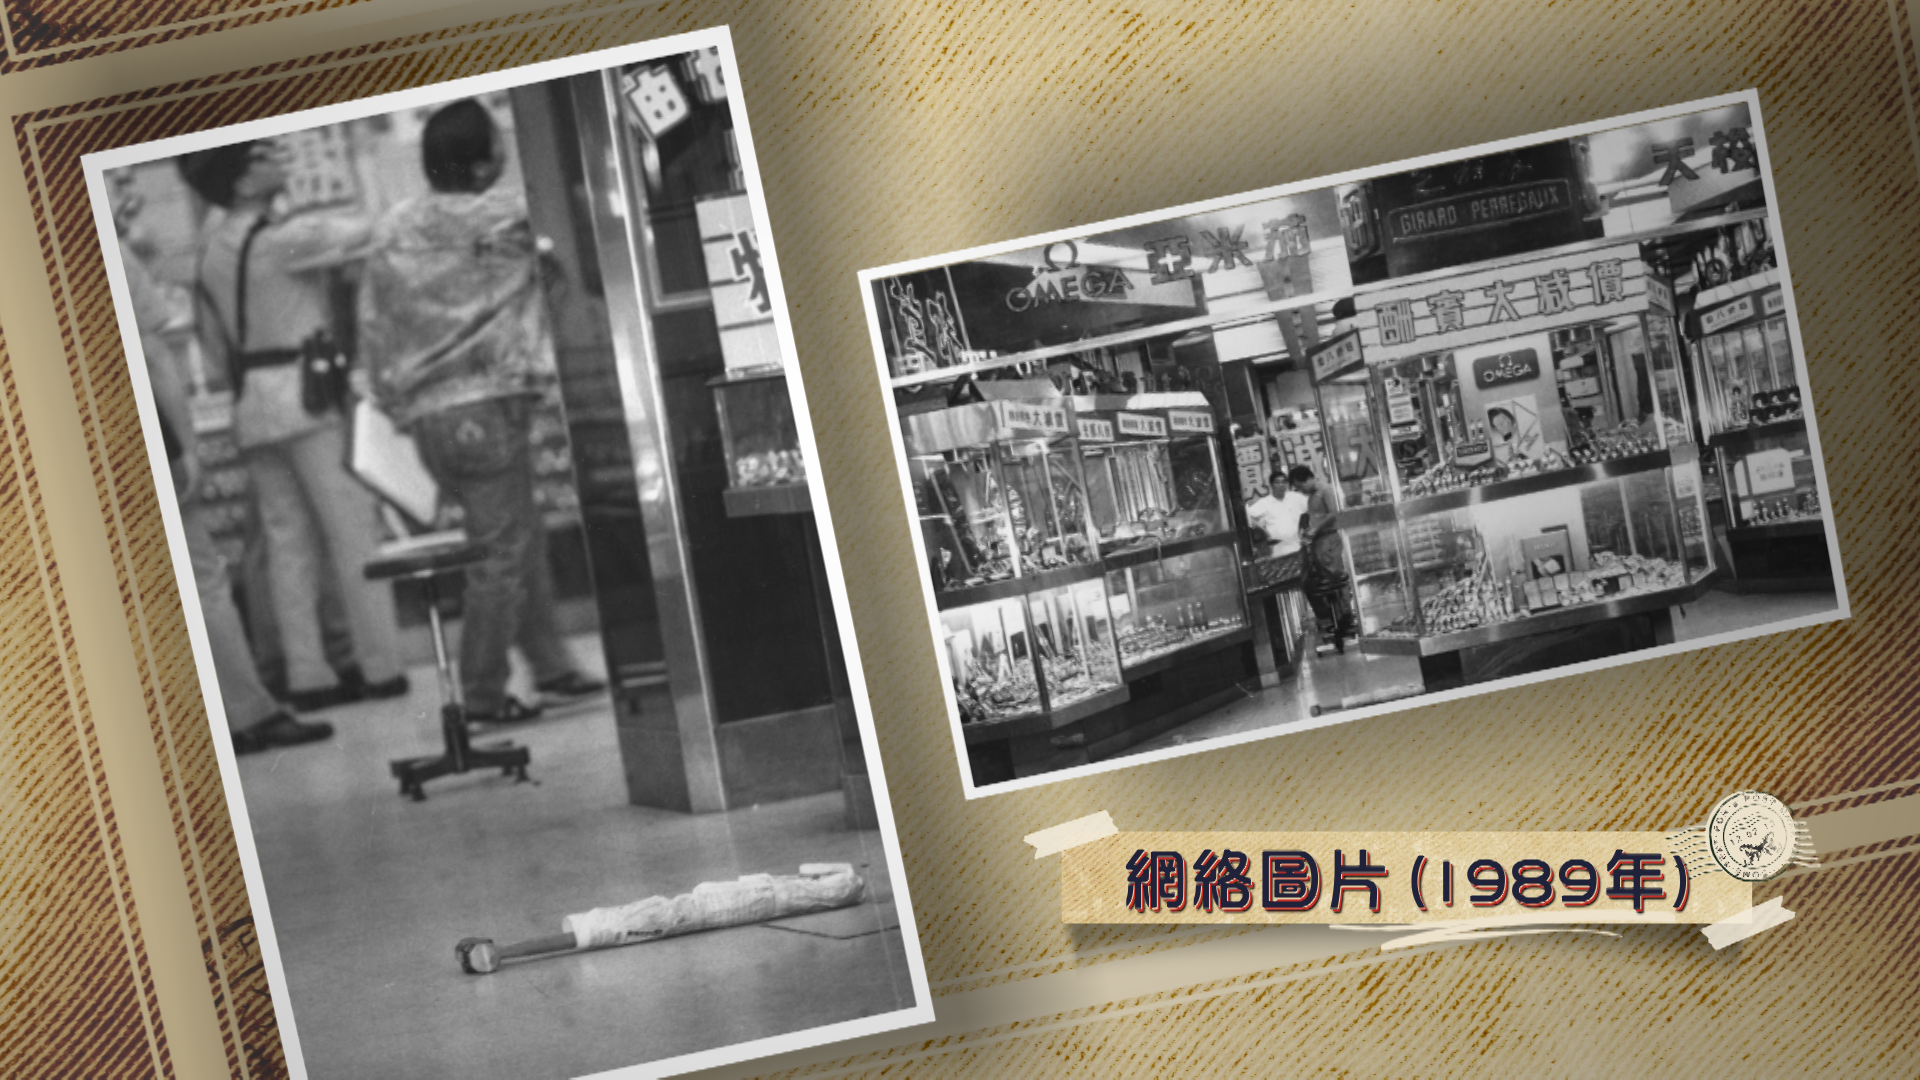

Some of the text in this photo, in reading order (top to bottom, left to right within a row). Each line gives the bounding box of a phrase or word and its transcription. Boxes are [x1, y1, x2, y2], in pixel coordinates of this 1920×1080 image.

[1400, 204, 1457, 235] GIRARD
[1470, 187, 1561, 219] PERREGAUX
[1005, 267, 1135, 313] OMEGA
[1482, 363, 1533, 383] OMEGA
